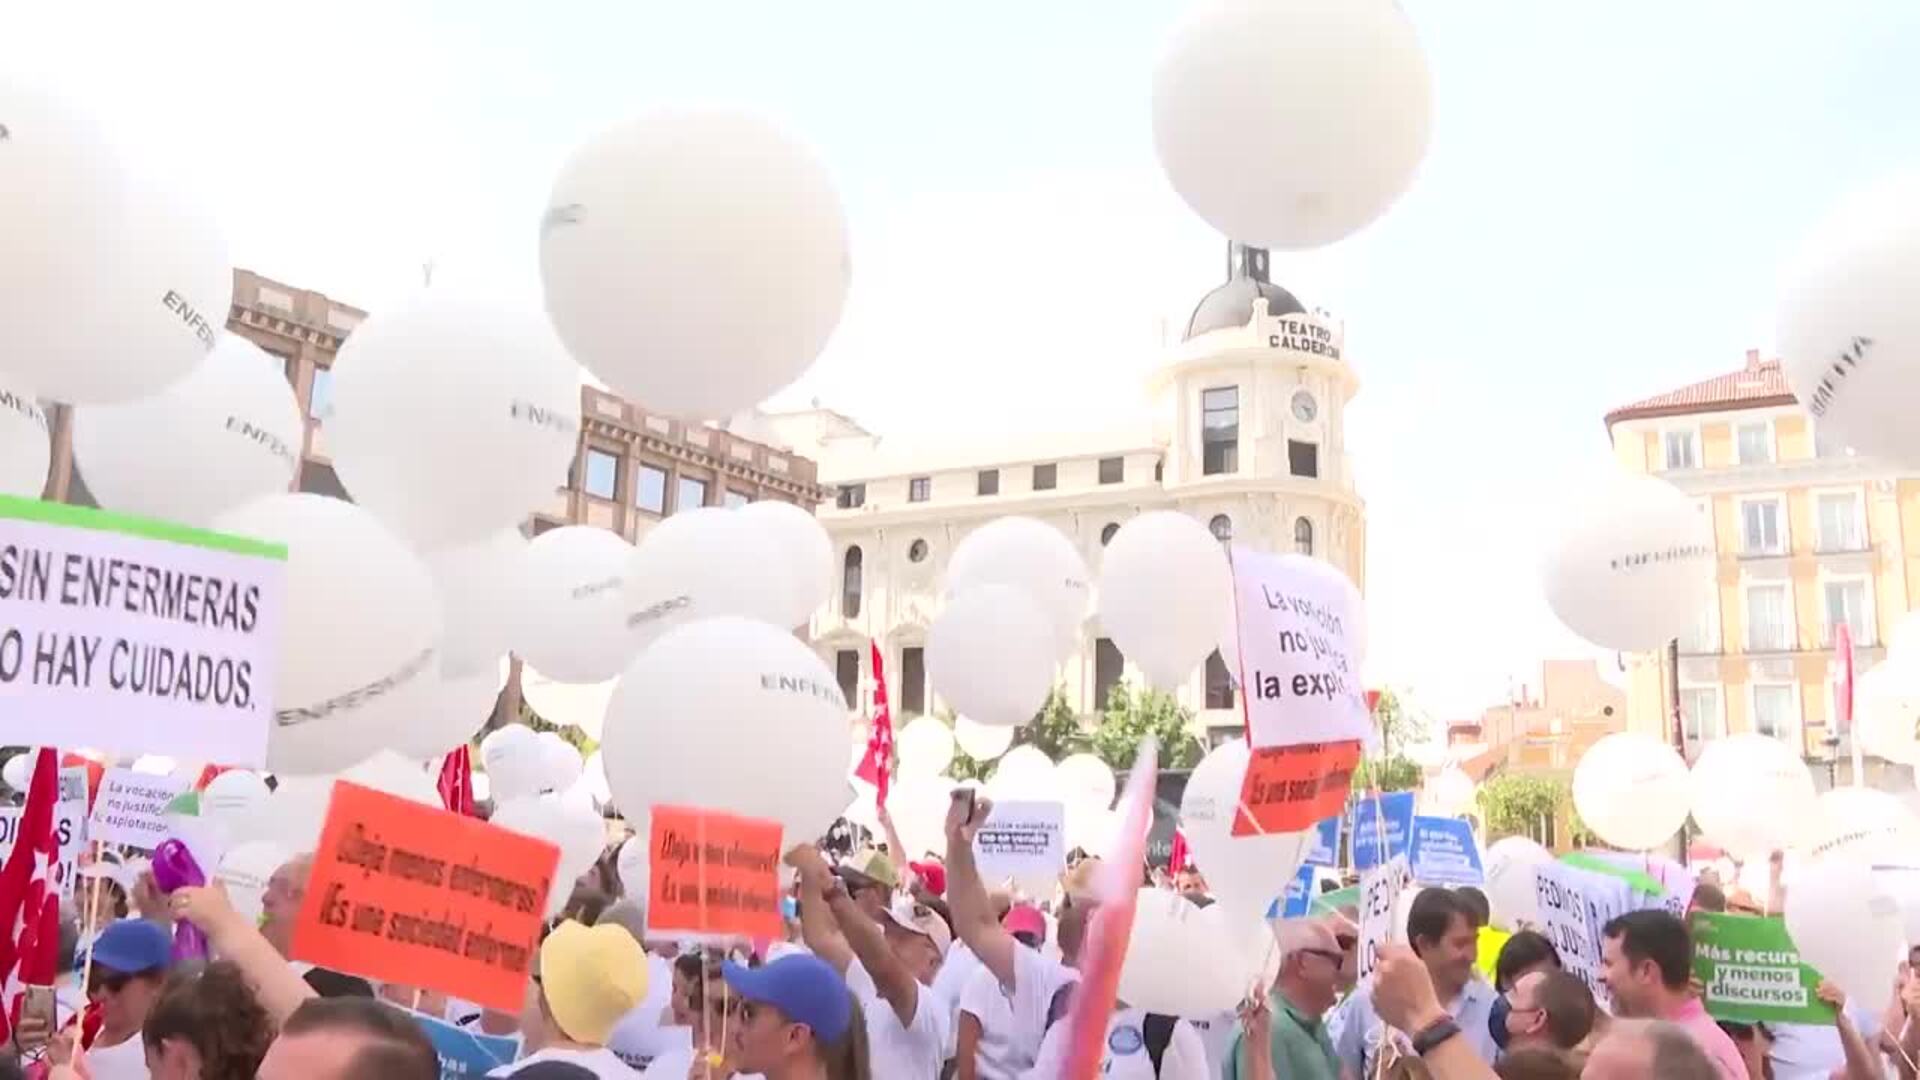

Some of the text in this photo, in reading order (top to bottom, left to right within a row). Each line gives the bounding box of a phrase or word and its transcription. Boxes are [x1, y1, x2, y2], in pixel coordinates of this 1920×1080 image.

[1278, 319, 1331, 343] TEATRO
[0, 545, 260, 633] SIN ENFERMERAS
[1280, 628, 1309, 653] no
[0, 629, 256, 711] O HAY CUIDADOS.
[1255, 670, 1281, 700] la
[1695, 943, 1800, 966] Más recurs
[1717, 967, 1794, 984] y menos
[1711, 983, 1803, 1002] discursos
